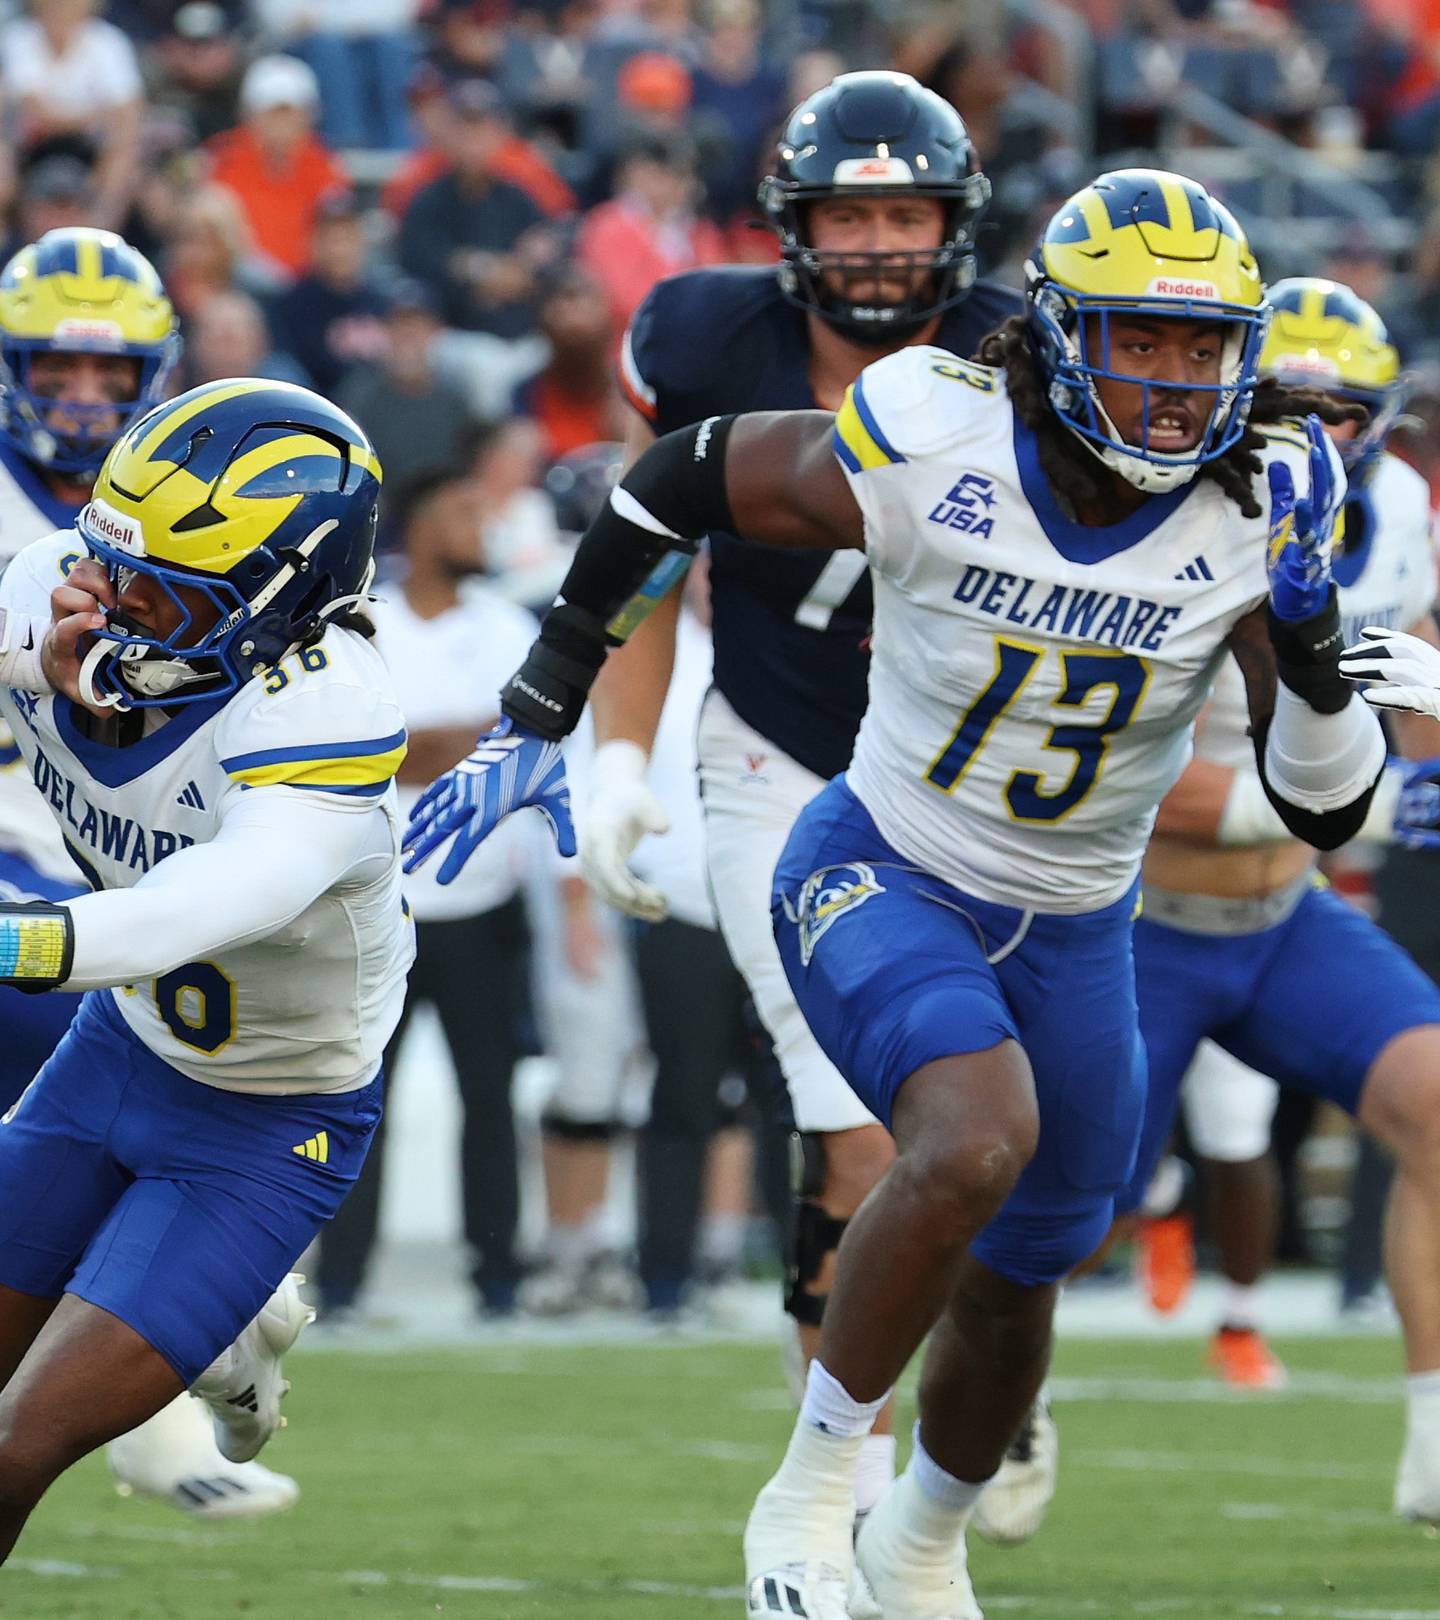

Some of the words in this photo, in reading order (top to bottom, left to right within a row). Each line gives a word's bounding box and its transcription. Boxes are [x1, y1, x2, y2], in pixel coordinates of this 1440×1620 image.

[1156, 281, 1214, 298] Riddell
[89, 508, 134, 545] Riddell
[928, 502, 995, 540] USA
[953, 564, 1183, 652] DELAWARE
[262, 645, 332, 697] 36
[921, 633, 1154, 825] 13
